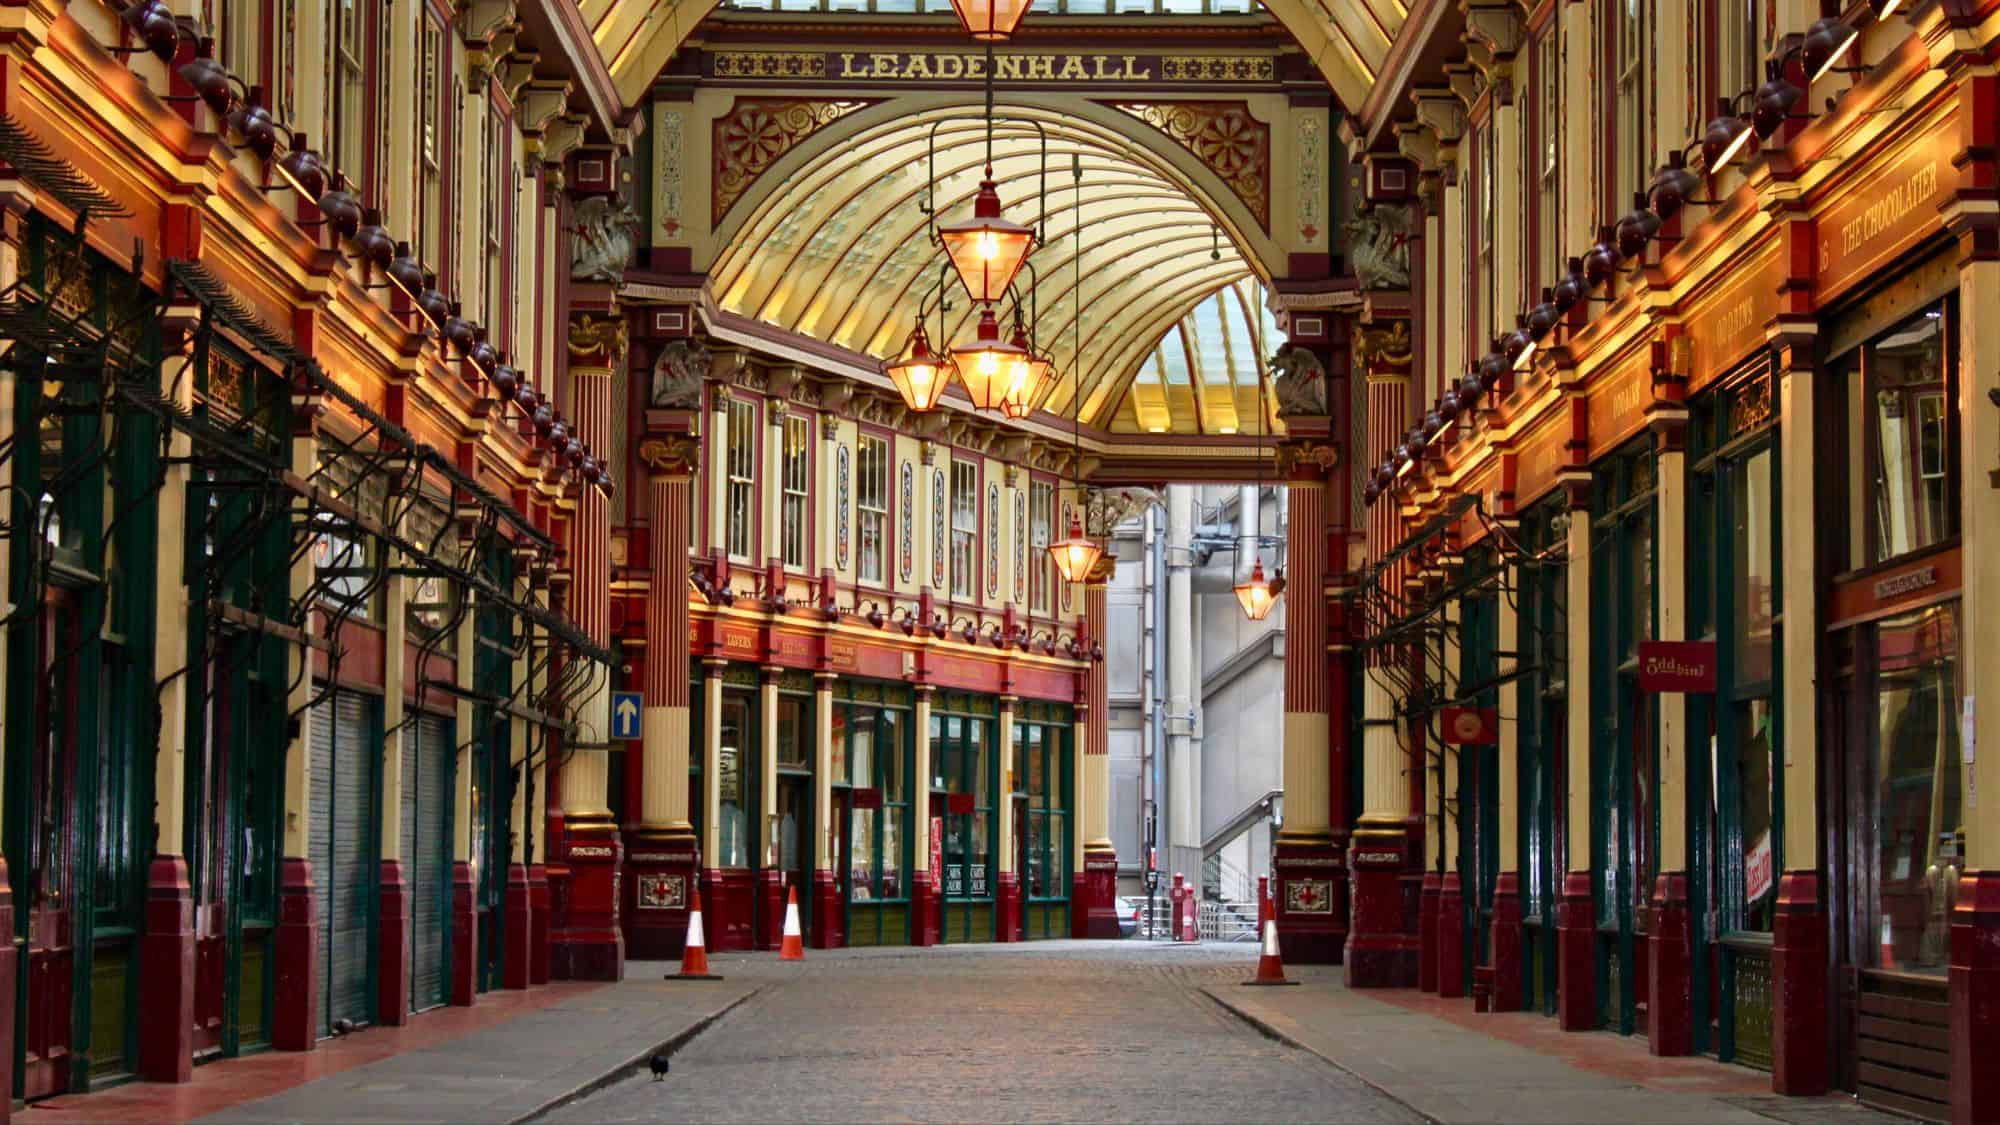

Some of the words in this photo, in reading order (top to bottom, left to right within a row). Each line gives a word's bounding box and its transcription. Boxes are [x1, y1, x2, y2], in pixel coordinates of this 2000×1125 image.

[840, 52, 1151, 80] LEADENHALL
[1842, 215, 1863, 257] THE
[1863, 160, 1937, 241] CHOCOLATIER
